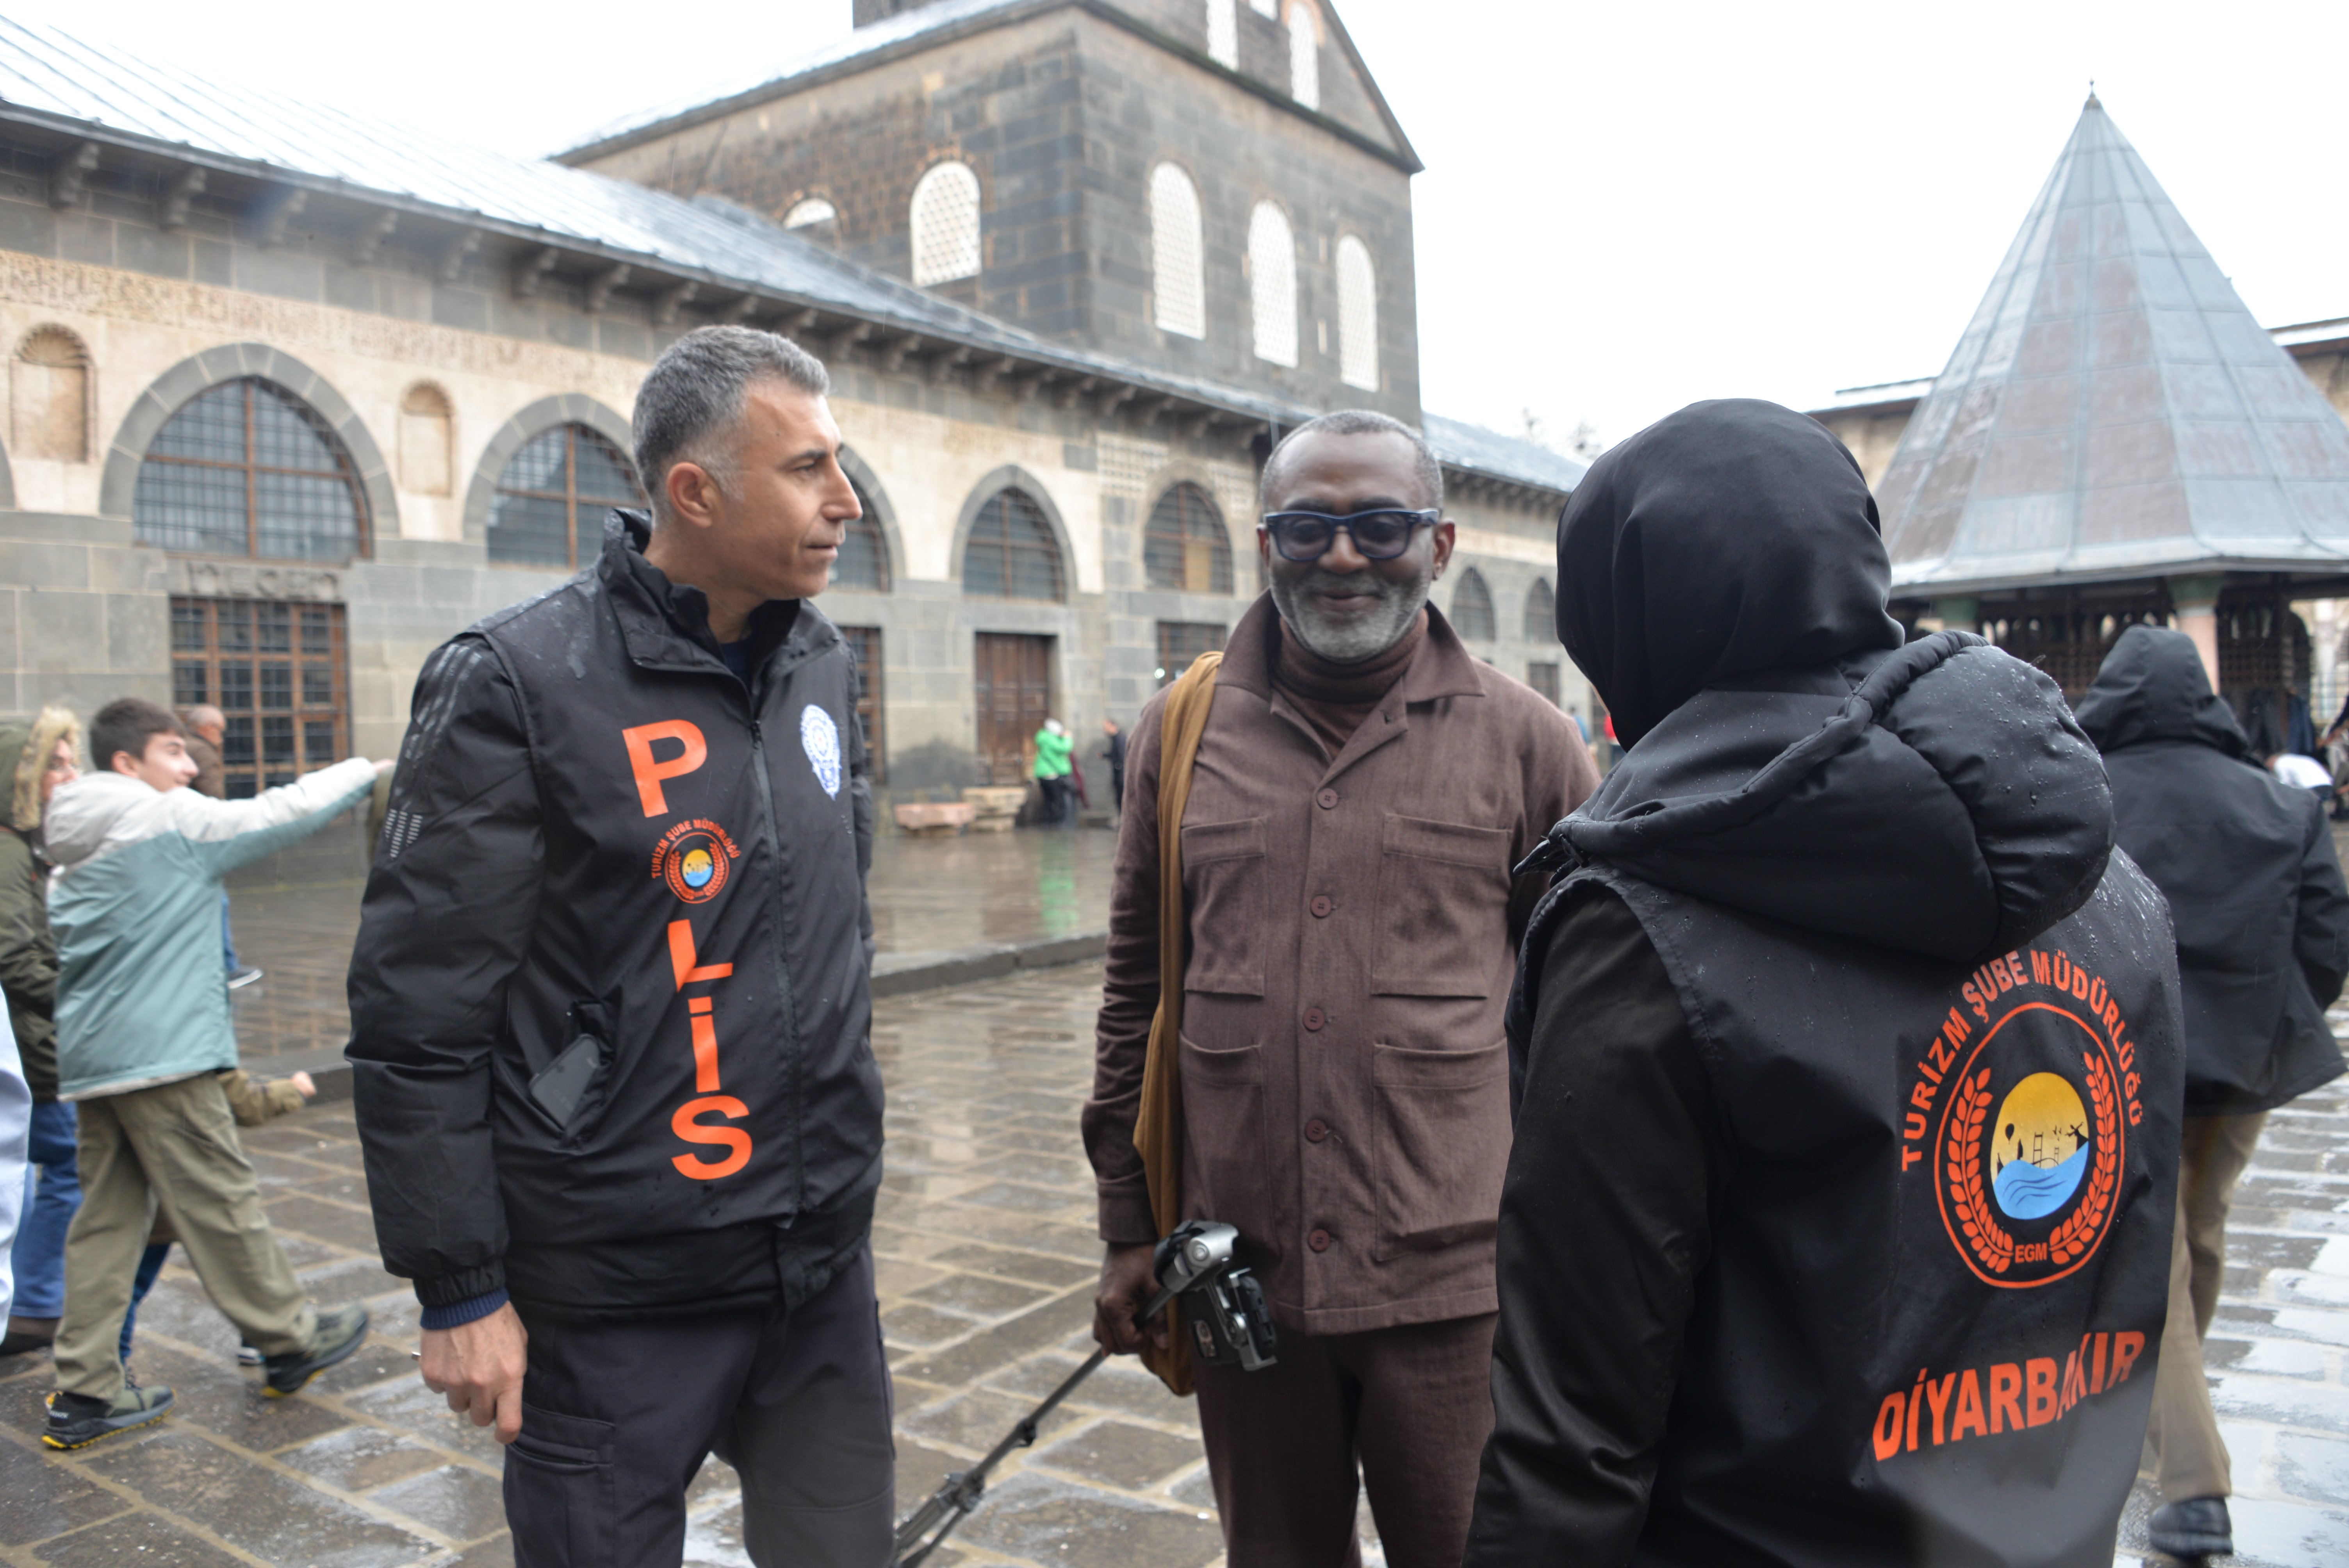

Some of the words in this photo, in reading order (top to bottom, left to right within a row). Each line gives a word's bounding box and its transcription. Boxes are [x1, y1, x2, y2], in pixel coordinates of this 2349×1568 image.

[651, 838, 670, 878] TURİZM
[665, 820, 692, 842] ŞUBE
[1902, 1007, 1971, 1171] TURİZM
[1962, 950, 2029, 1023] ŞUBE
[2031, 949, 2143, 1127] MÜDÜRLÜĞÜ
[2015, 1242, 2048, 1263] EGM
[1873, 1331, 2145, 1462] DİYARBAKIR
